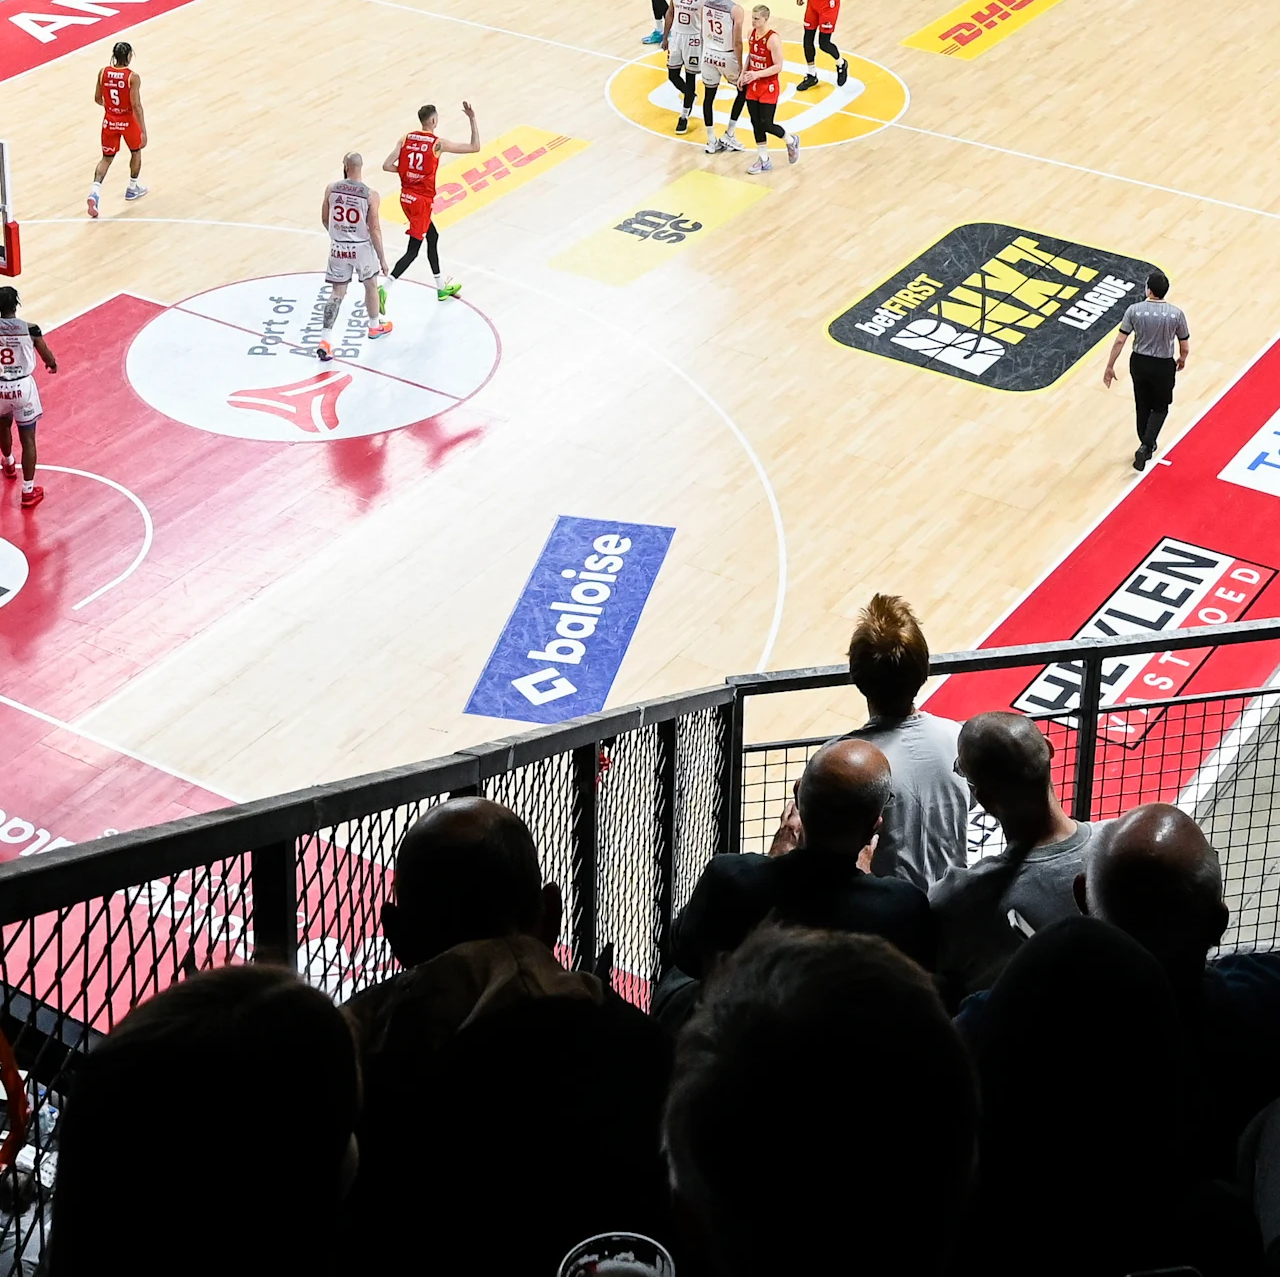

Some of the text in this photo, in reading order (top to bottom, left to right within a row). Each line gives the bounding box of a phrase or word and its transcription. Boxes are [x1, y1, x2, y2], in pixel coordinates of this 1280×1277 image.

[829, 0, 835, 9] 8
[708, 19, 723, 35] 13
[688, 39, 700, 47] 29
[768, 83, 775, 93] 6
[110, 89, 120, 106] 5
[407, 152, 424, 171] 12
[432, 143, 549, 215] DHL
[333, 205, 360, 224] 30
[854, 272, 945, 338] betFIRST
[1057, 274, 1136, 331] LEAGUE
[1134, 309, 1177, 320] VOLVO
[247, 296, 297, 356] Port of
[0, 348, 15, 365] 8
[526, 534, 632, 665] baloise
